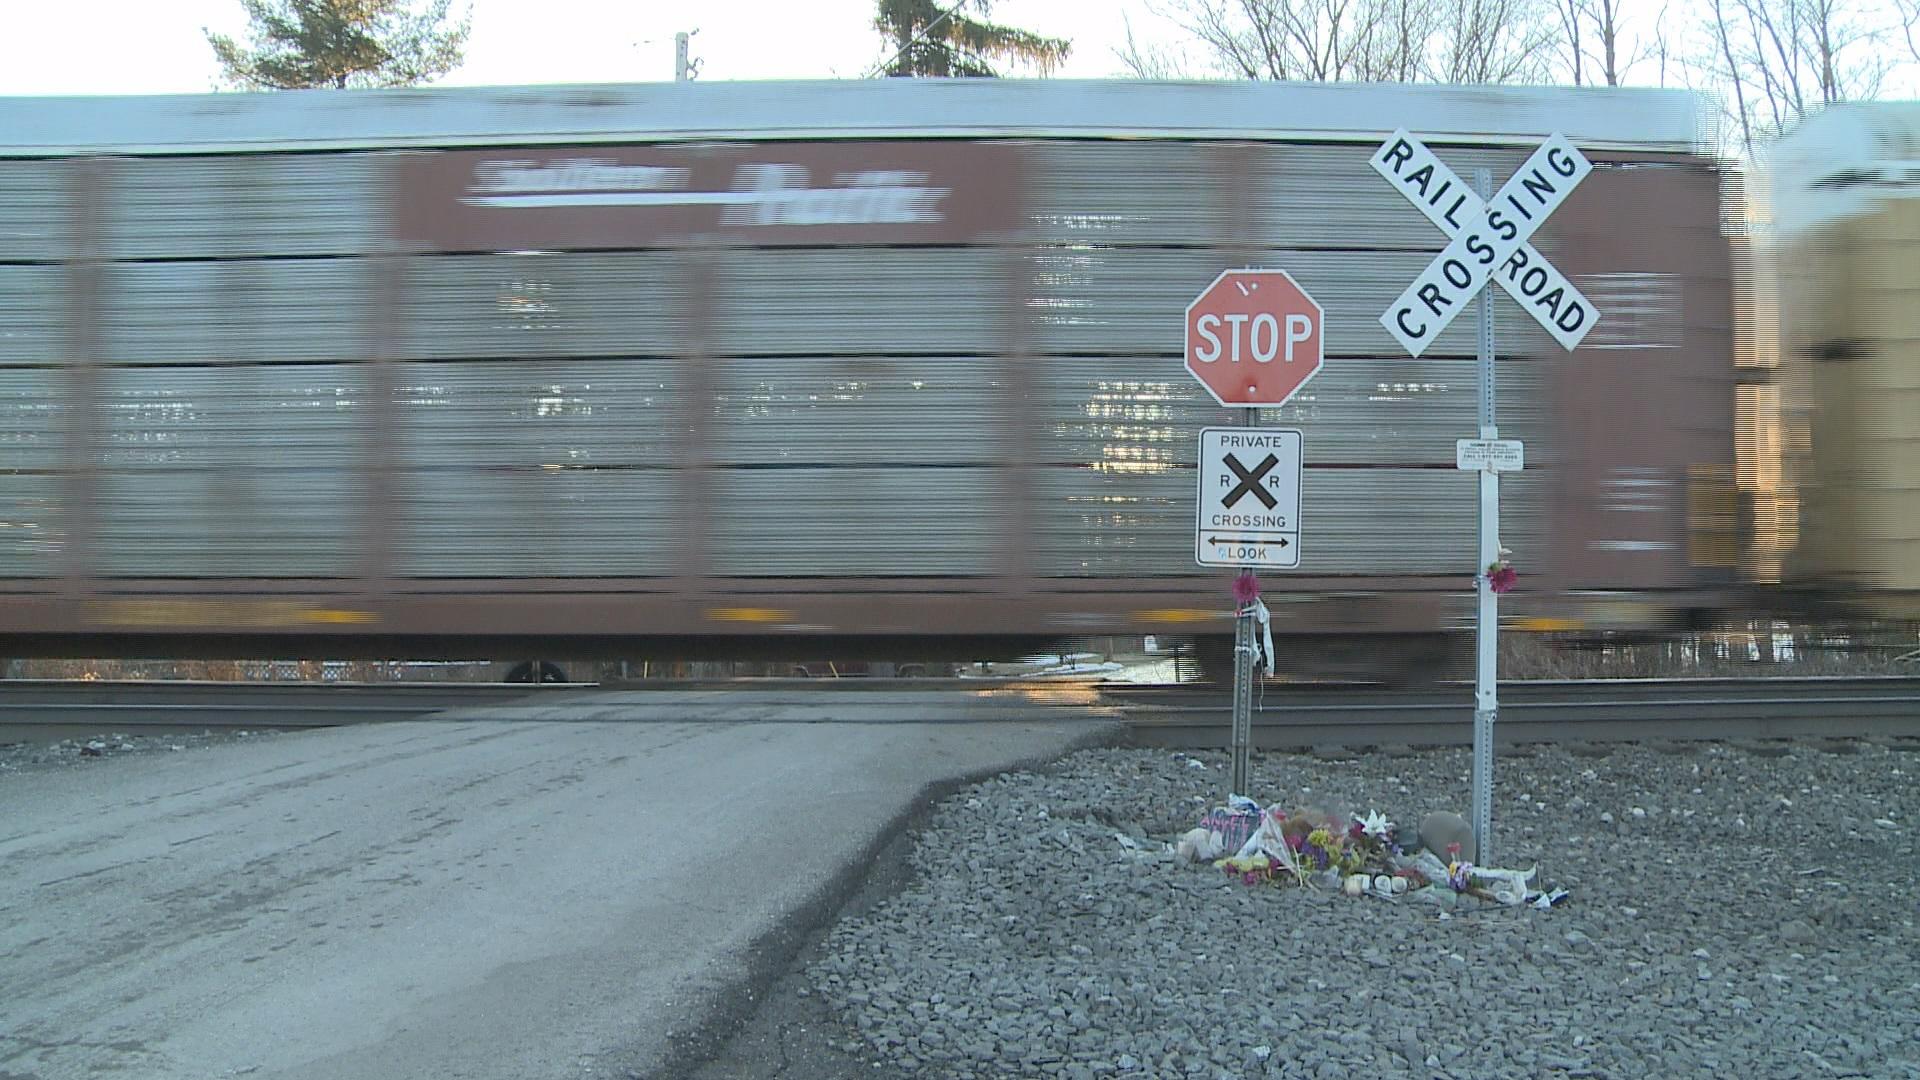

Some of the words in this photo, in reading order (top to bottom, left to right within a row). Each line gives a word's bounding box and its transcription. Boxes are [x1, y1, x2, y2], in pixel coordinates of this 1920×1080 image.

[1382, 137, 1466, 229] RAIL
[1500, 248, 1584, 332] ROAD
[1397, 147, 1575, 338] CROSSING
[1195, 313, 1312, 363] STOP
[1221, 435, 1281, 447] PRIVATE
[1220, 475, 1230, 487] R
[1269, 475, 1279, 488] R
[1212, 515, 1286, 527] CROSSING
[1228, 547, 1267, 559] LOOK
